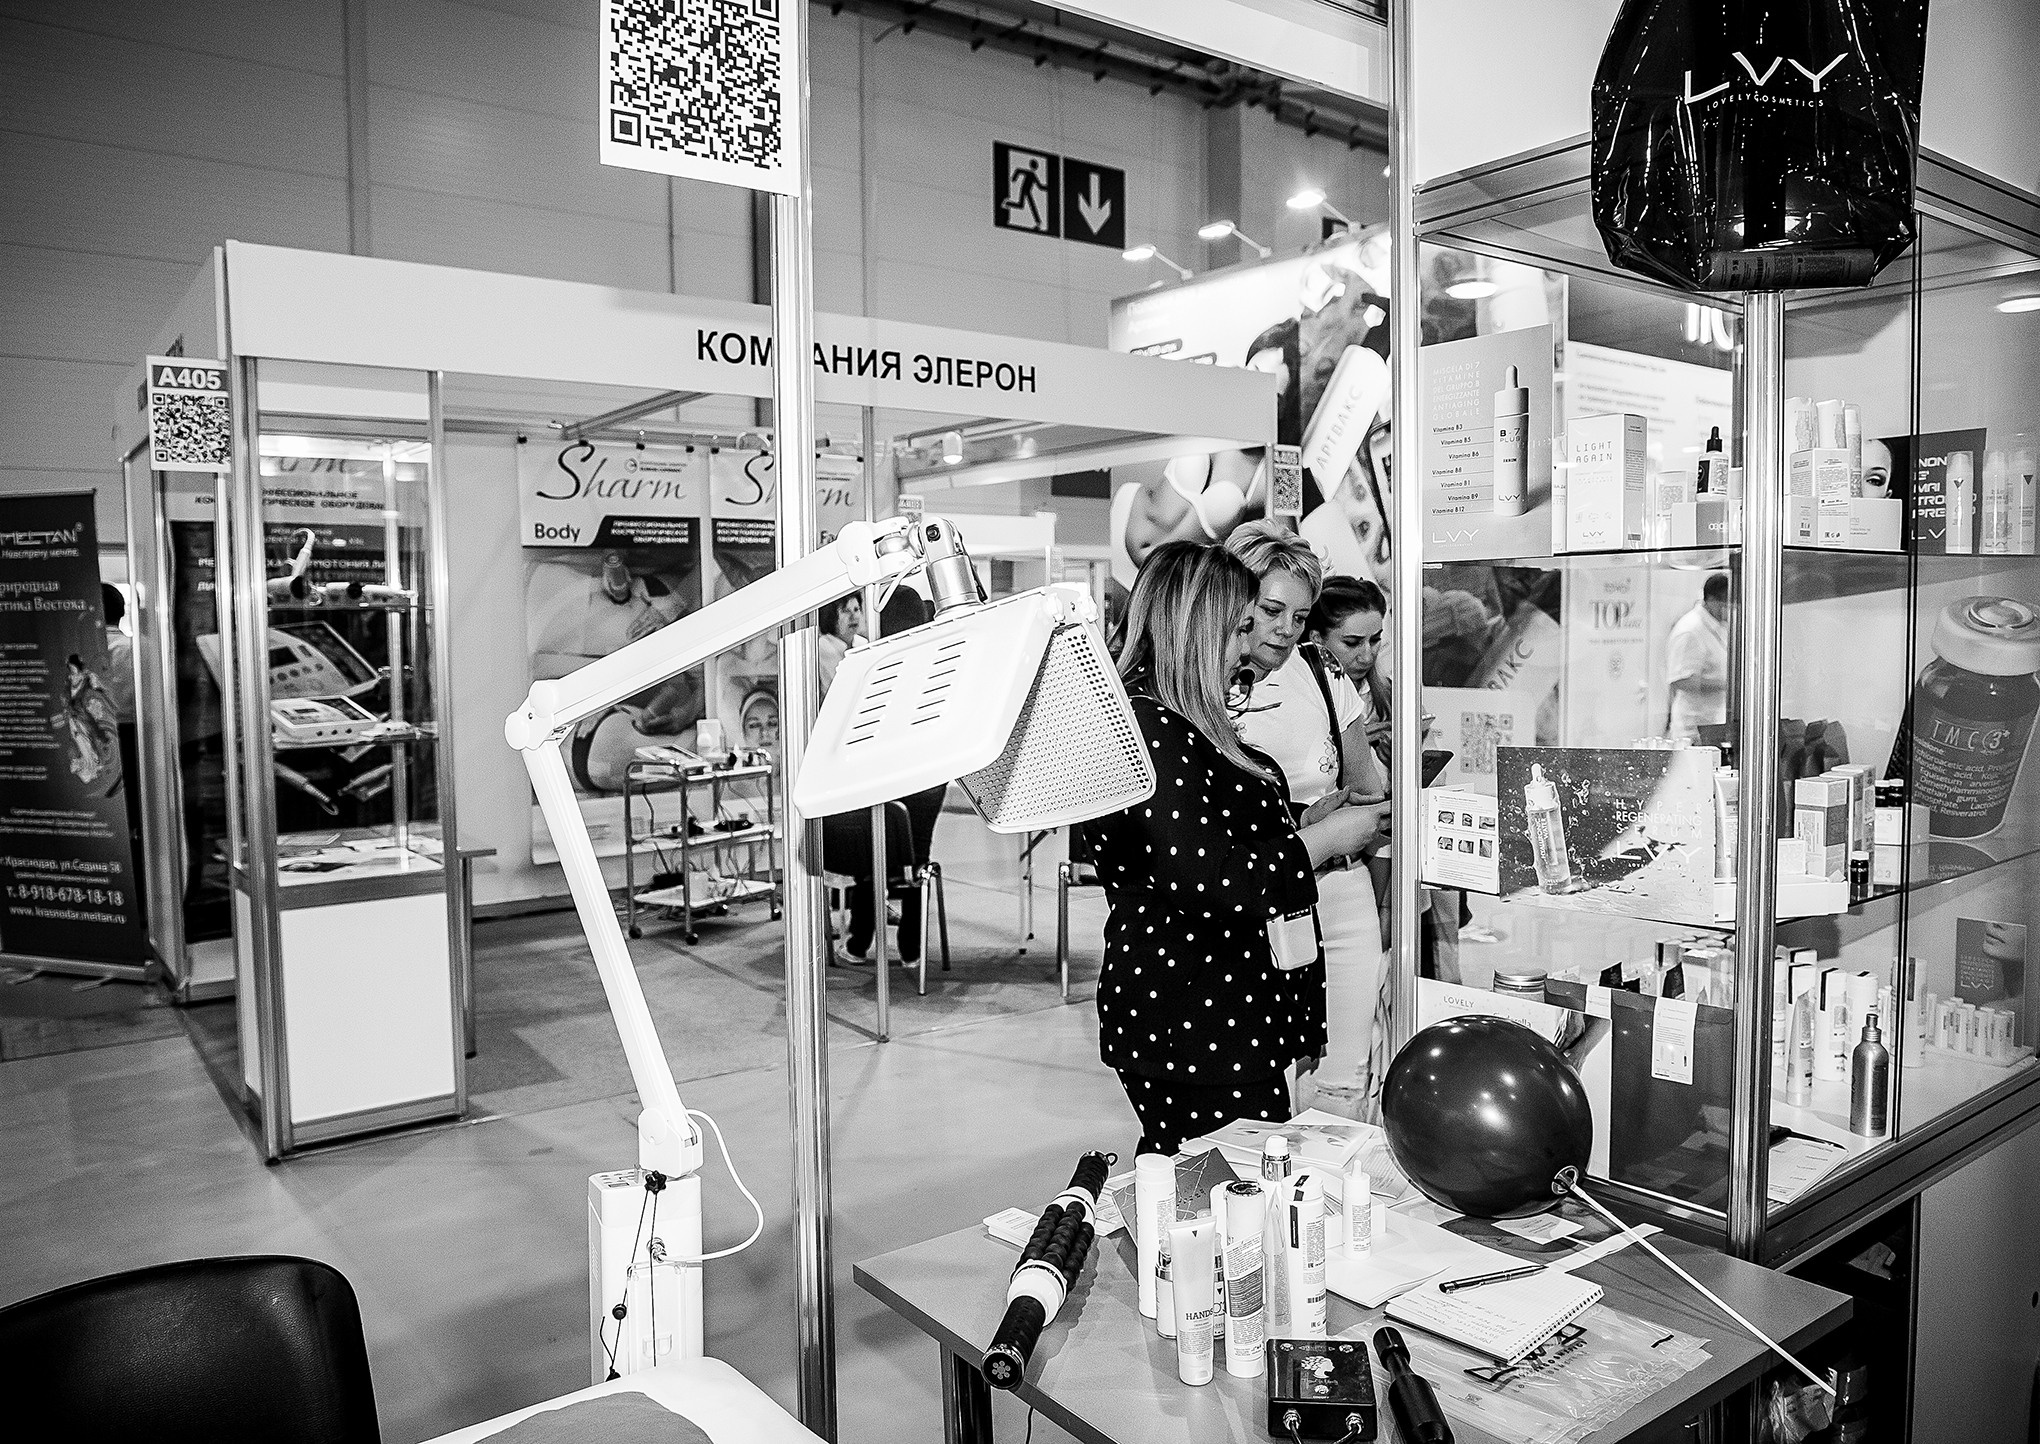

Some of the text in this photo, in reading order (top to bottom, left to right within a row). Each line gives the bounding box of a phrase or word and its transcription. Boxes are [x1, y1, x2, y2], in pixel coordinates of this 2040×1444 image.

[1684, 51, 1848, 104] LVY
[697, 329, 1036, 393] КОМАНИЯ ЭЛЕРОН
[157, 366, 222, 390] A405
[1576, 440, 1612, 452] LIGHT
[1576, 453, 1613, 463] AGAIN
[536, 443, 687, 500] Sharm
[534, 522, 580, 542] Body
[1432, 529, 1479, 543] LVY
[1582, 530, 1604, 538] LVY
[1615, 811, 1703, 826] REGENERATING
[1615, 822, 1703, 839] SERUM
[1616, 840, 1703, 864] LVY
[1443, 995, 1475, 1009] LOVELY
[1185, 1308, 1214, 1321] HANDS
